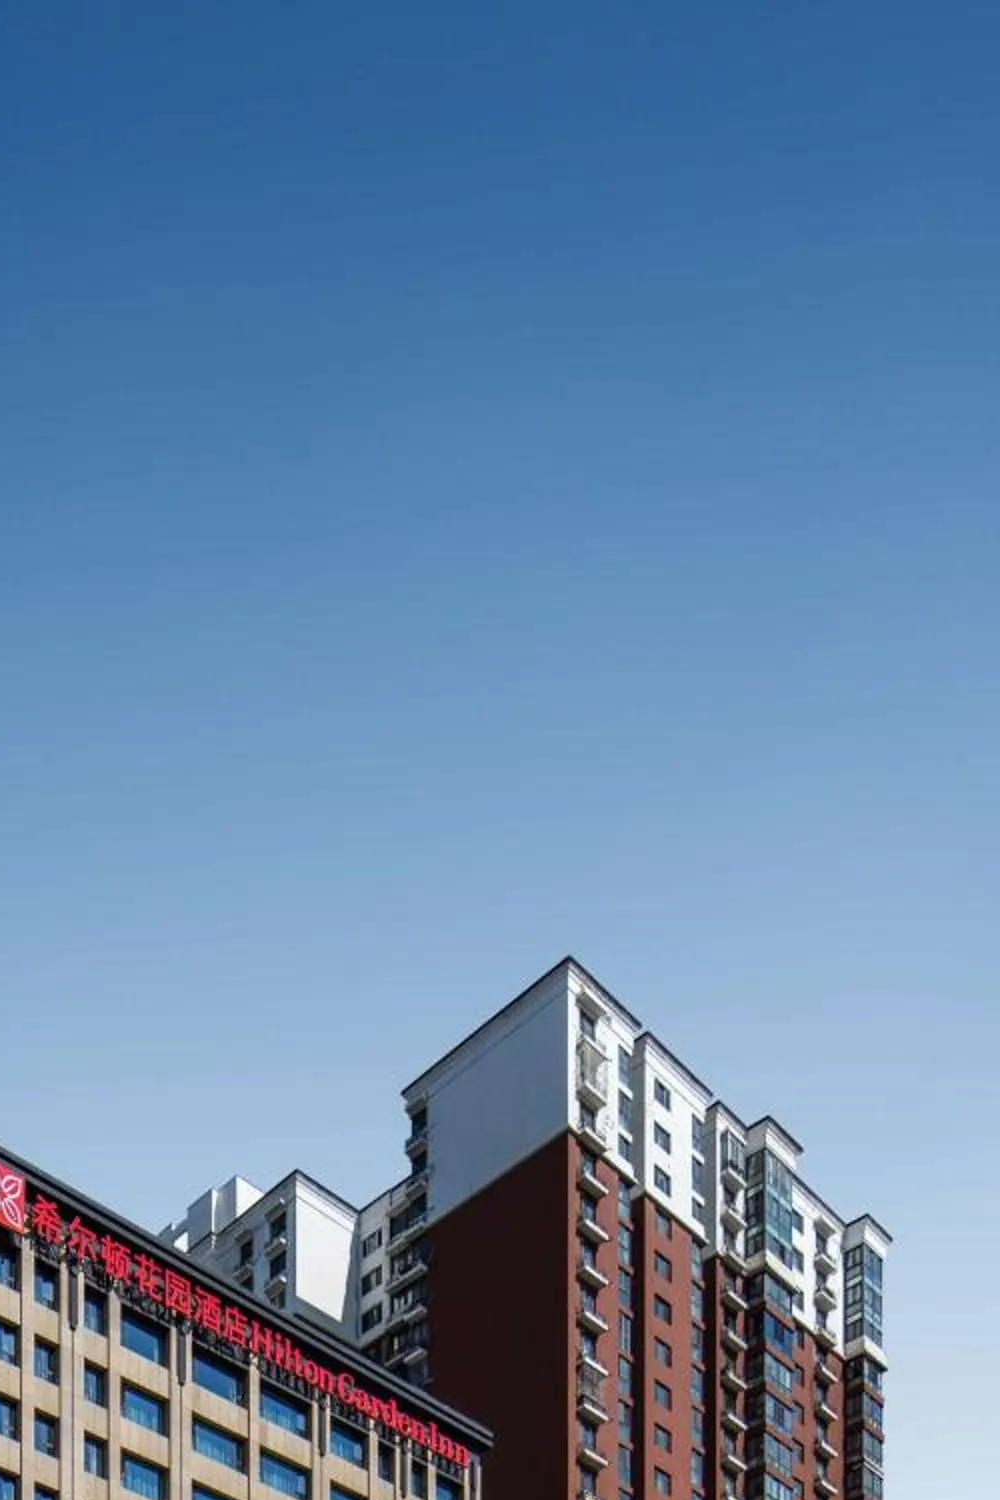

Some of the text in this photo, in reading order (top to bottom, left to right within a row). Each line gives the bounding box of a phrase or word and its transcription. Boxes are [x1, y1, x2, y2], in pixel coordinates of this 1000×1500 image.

[32, 1194, 249, 1347] 希尔顿花园酒店
[251, 1319, 470, 1468] Hilton Garden Inn
